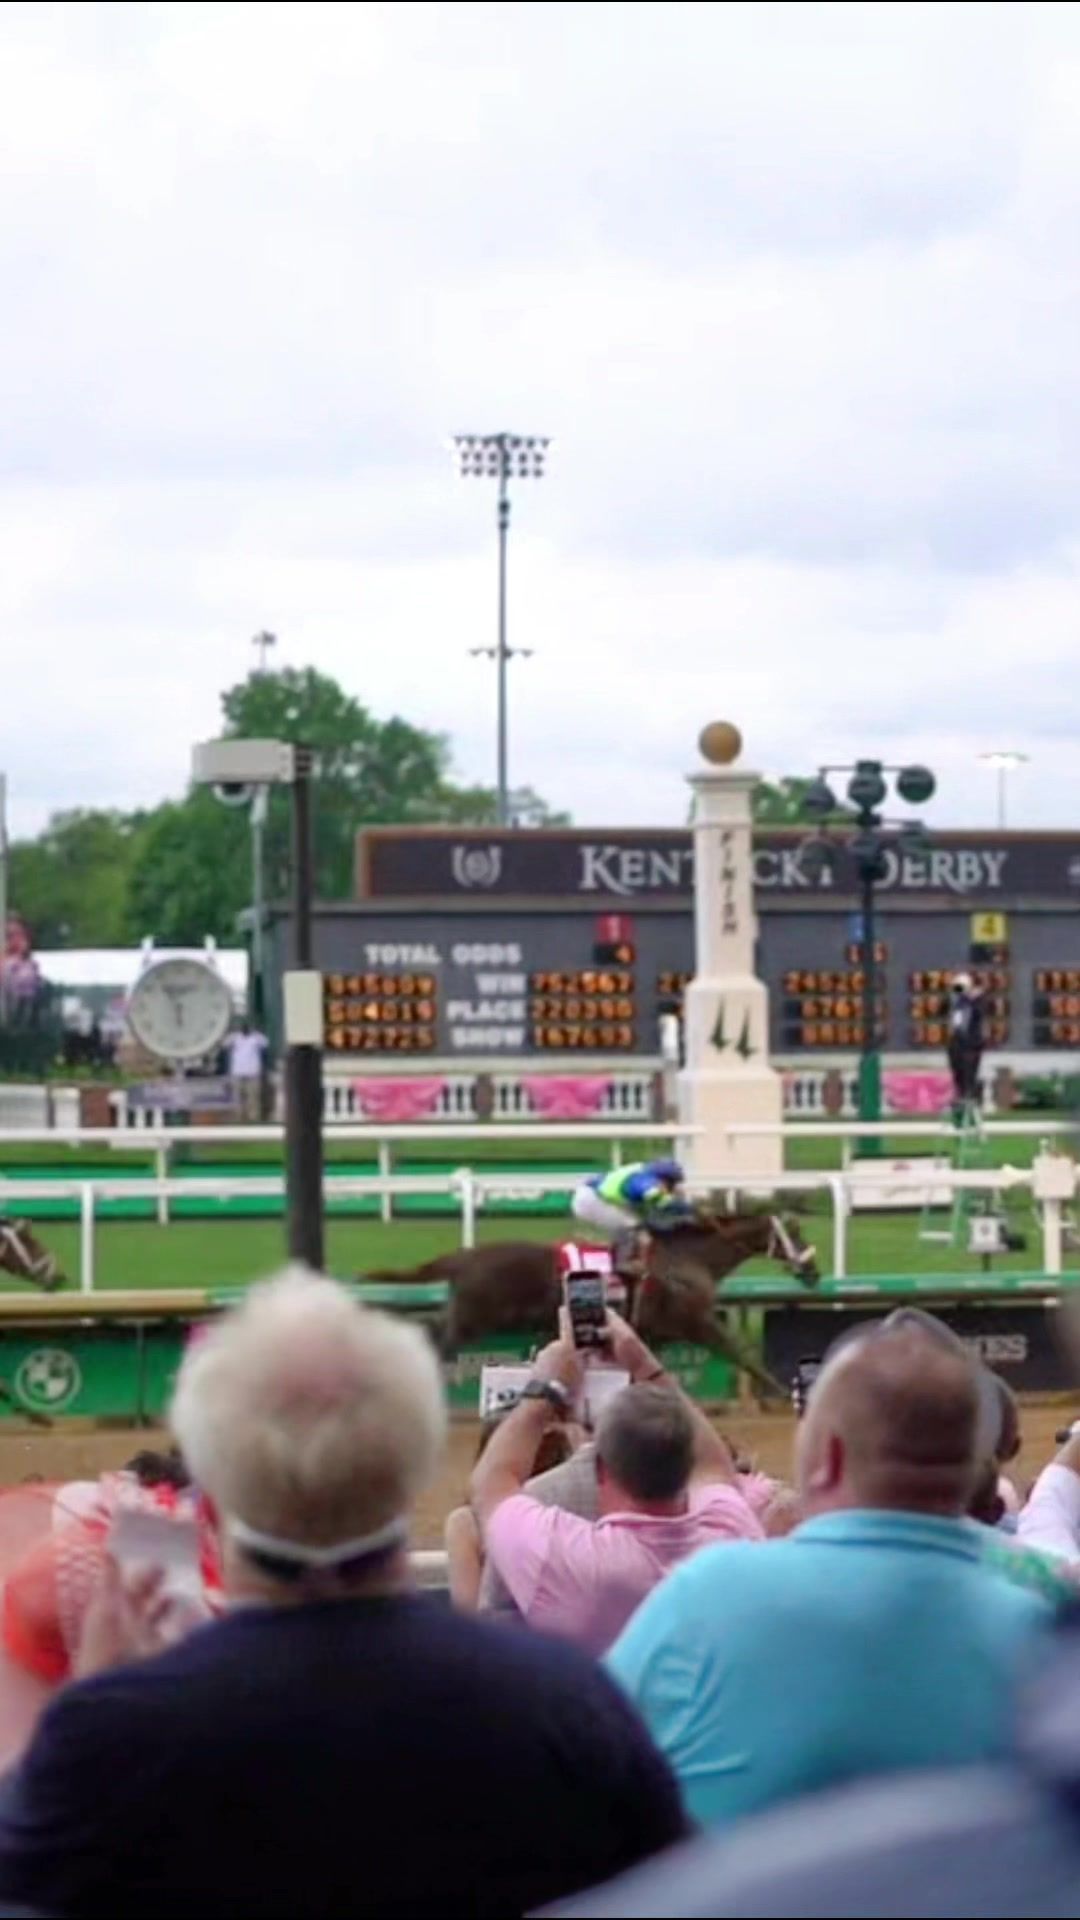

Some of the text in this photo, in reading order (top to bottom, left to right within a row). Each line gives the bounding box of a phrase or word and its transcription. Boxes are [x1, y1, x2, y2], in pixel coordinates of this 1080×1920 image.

[578, 845, 834, 895] KENCK
[719, 831, 738, 933] FINISH
[363, 943, 522, 965] TOTAL ODDS
[475, 972, 527, 994] WIN
[446, 1000, 527, 1022] PLACE
[451, 1026, 526, 1048] SHOW
